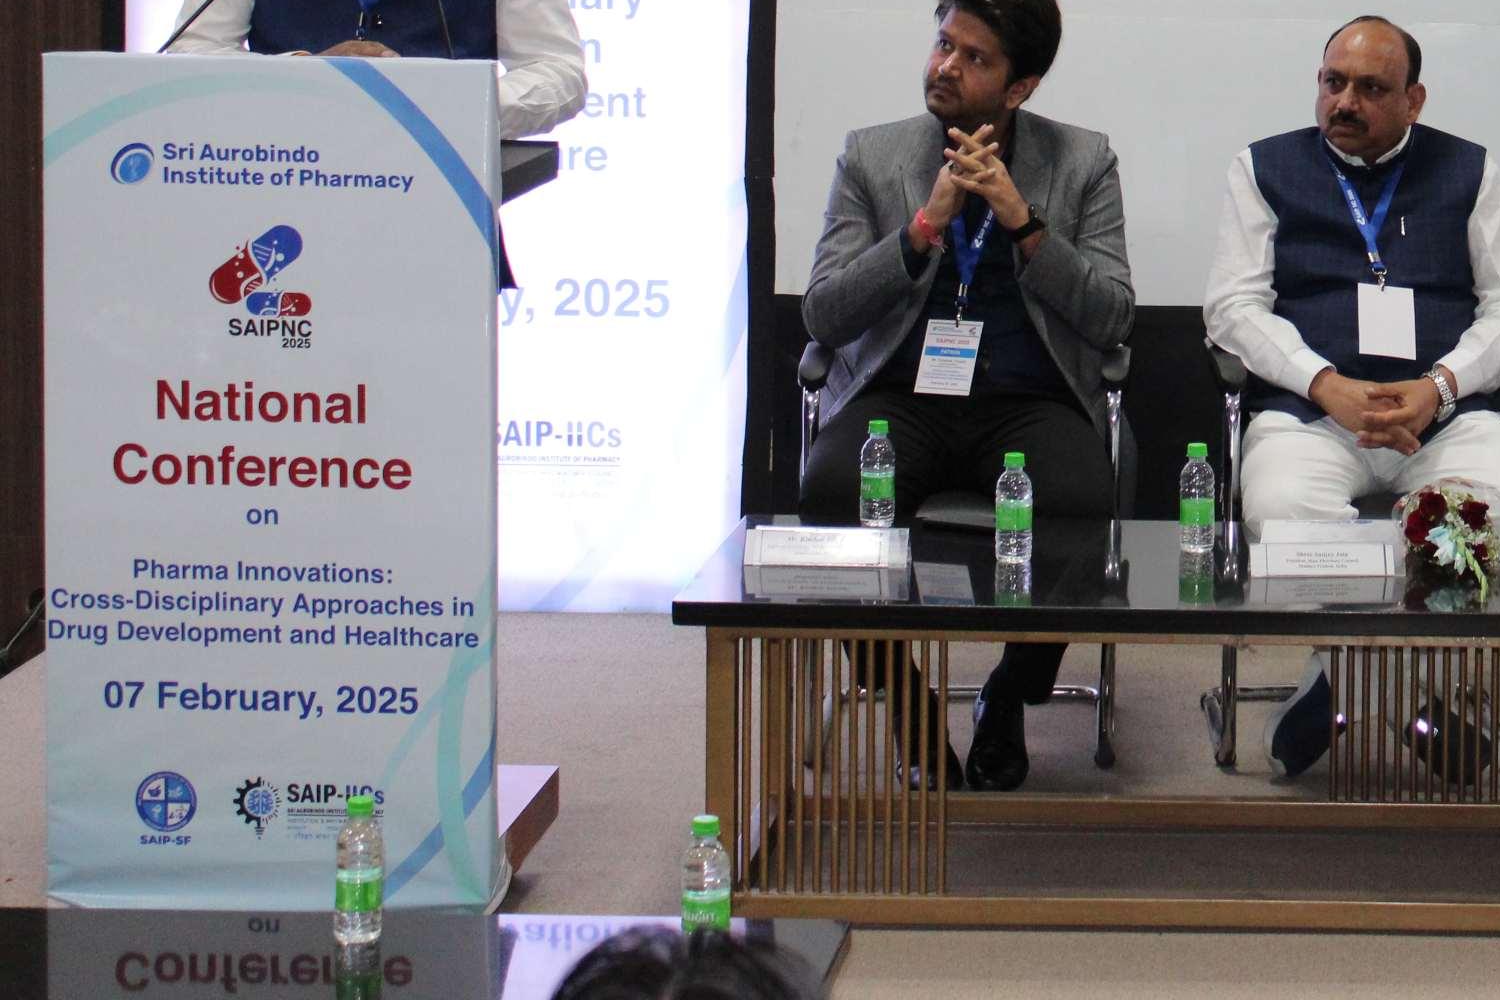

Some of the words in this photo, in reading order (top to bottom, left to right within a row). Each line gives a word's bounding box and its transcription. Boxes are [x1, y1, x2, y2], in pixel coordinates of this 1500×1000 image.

[163, 143, 194, 160] Sri
[200, 144, 319, 163] Aurobindo
[164, 167, 264, 185] Institute
[271, 168, 294, 186] of
[299, 169, 413, 192] Pharmacy
[555, 278, 669, 318] 2025
[229, 317, 311, 337] SAIPNC
[282, 338, 310, 348] 2025
[157, 380, 365, 424] National
[113, 443, 411, 490] Conference
[247, 509, 278, 524] on
[134, 559, 228, 580] Pharma
[238, 561, 392, 583] Innovations:
[51, 588, 283, 617] Cross-Disciplinary
[293, 593, 443, 619] Approaches
[453, 597, 474, 617] in
[49, 619, 107, 645] Drug
[118, 621, 281, 647] Development
[290, 625, 335, 644] and
[345, 626, 479, 648] Healthcare
[104, 681, 144, 708] 07
[158, 681, 323, 719] February,
[337, 686, 418, 714] 2025
[140, 835, 191, 845] SAIP-SF
